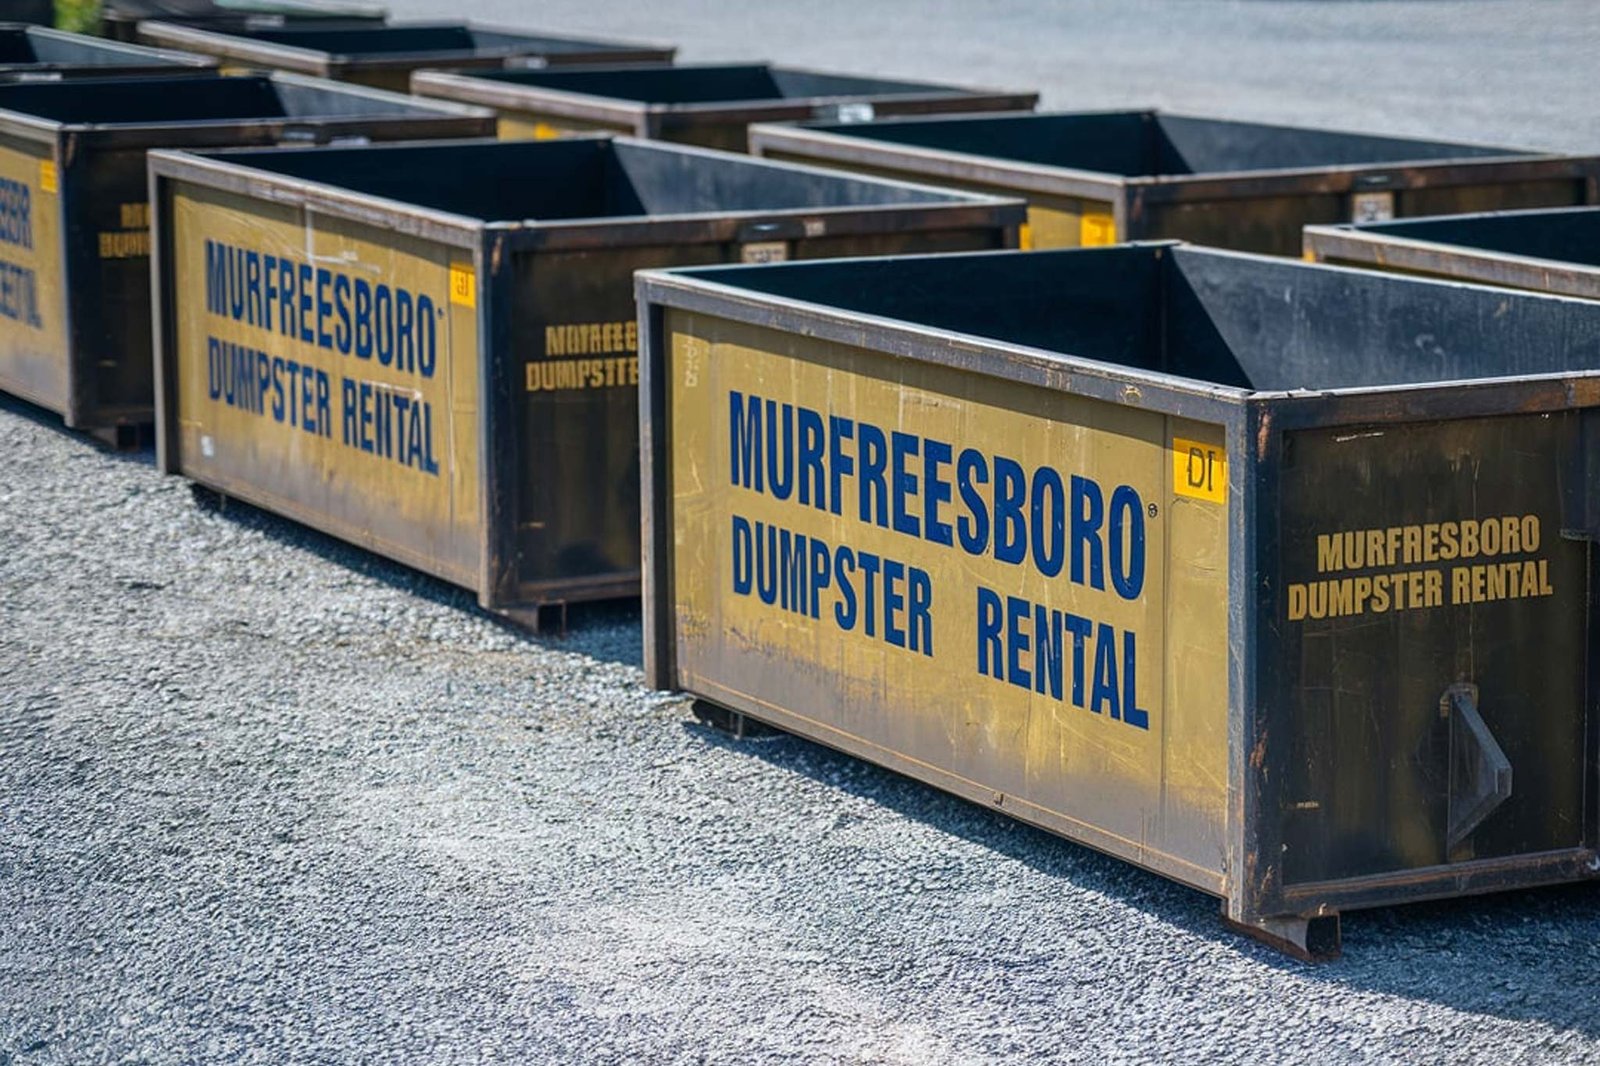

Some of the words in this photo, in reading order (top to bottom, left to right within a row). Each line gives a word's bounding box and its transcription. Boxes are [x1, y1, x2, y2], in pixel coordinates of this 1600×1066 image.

[205, 238, 436, 379] MURFREESBORO
[207, 335, 332, 439] DUMPSTER
[729, 390, 1145, 601] MURFREESBORO
[731, 514, 933, 658] DUMPSTER
[976, 586, 1149, 730] RENTAL
[1288, 569, 1443, 621] DUMPSTER
[1452, 560, 1553, 605] RENTAL
